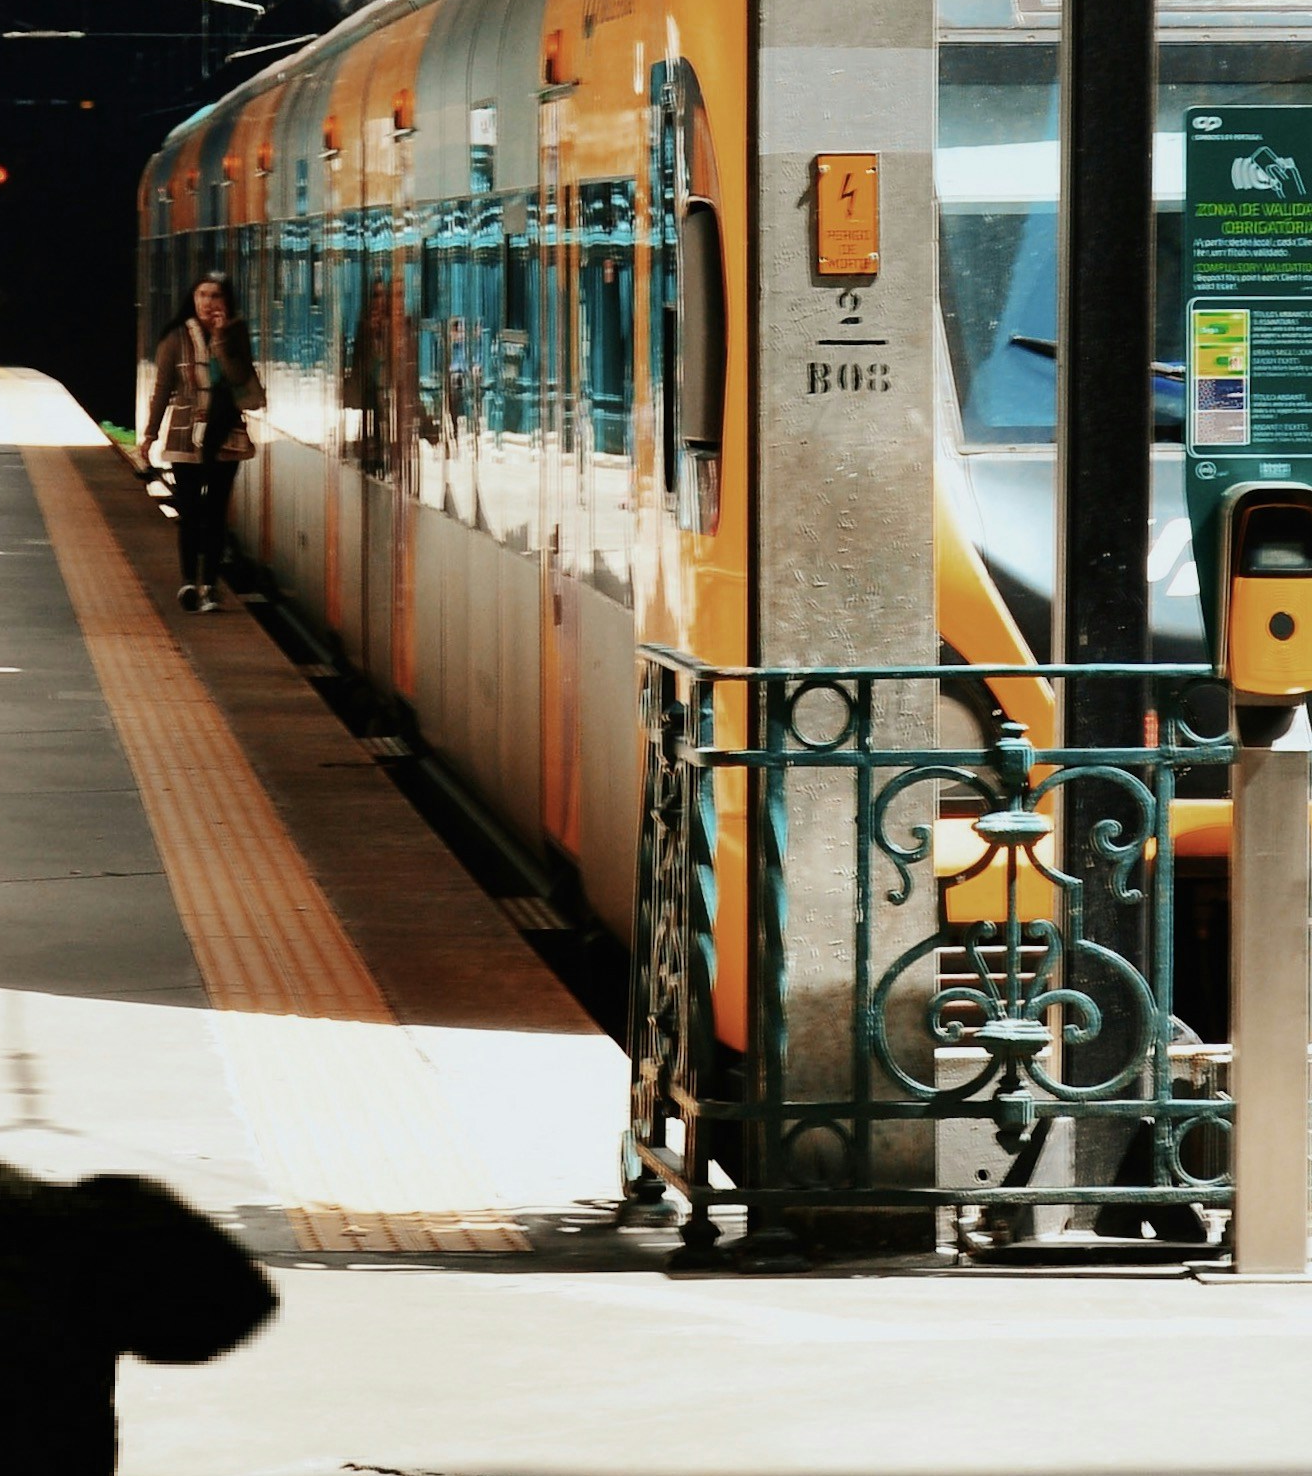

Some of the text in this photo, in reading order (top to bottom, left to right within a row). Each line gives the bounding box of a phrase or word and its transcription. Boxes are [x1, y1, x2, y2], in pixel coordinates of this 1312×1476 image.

[1195, 202, 1238, 217] ZONA
[1239, 202, 1261, 217] DE
[1193, 262, 1260, 273] COMPULSORY
